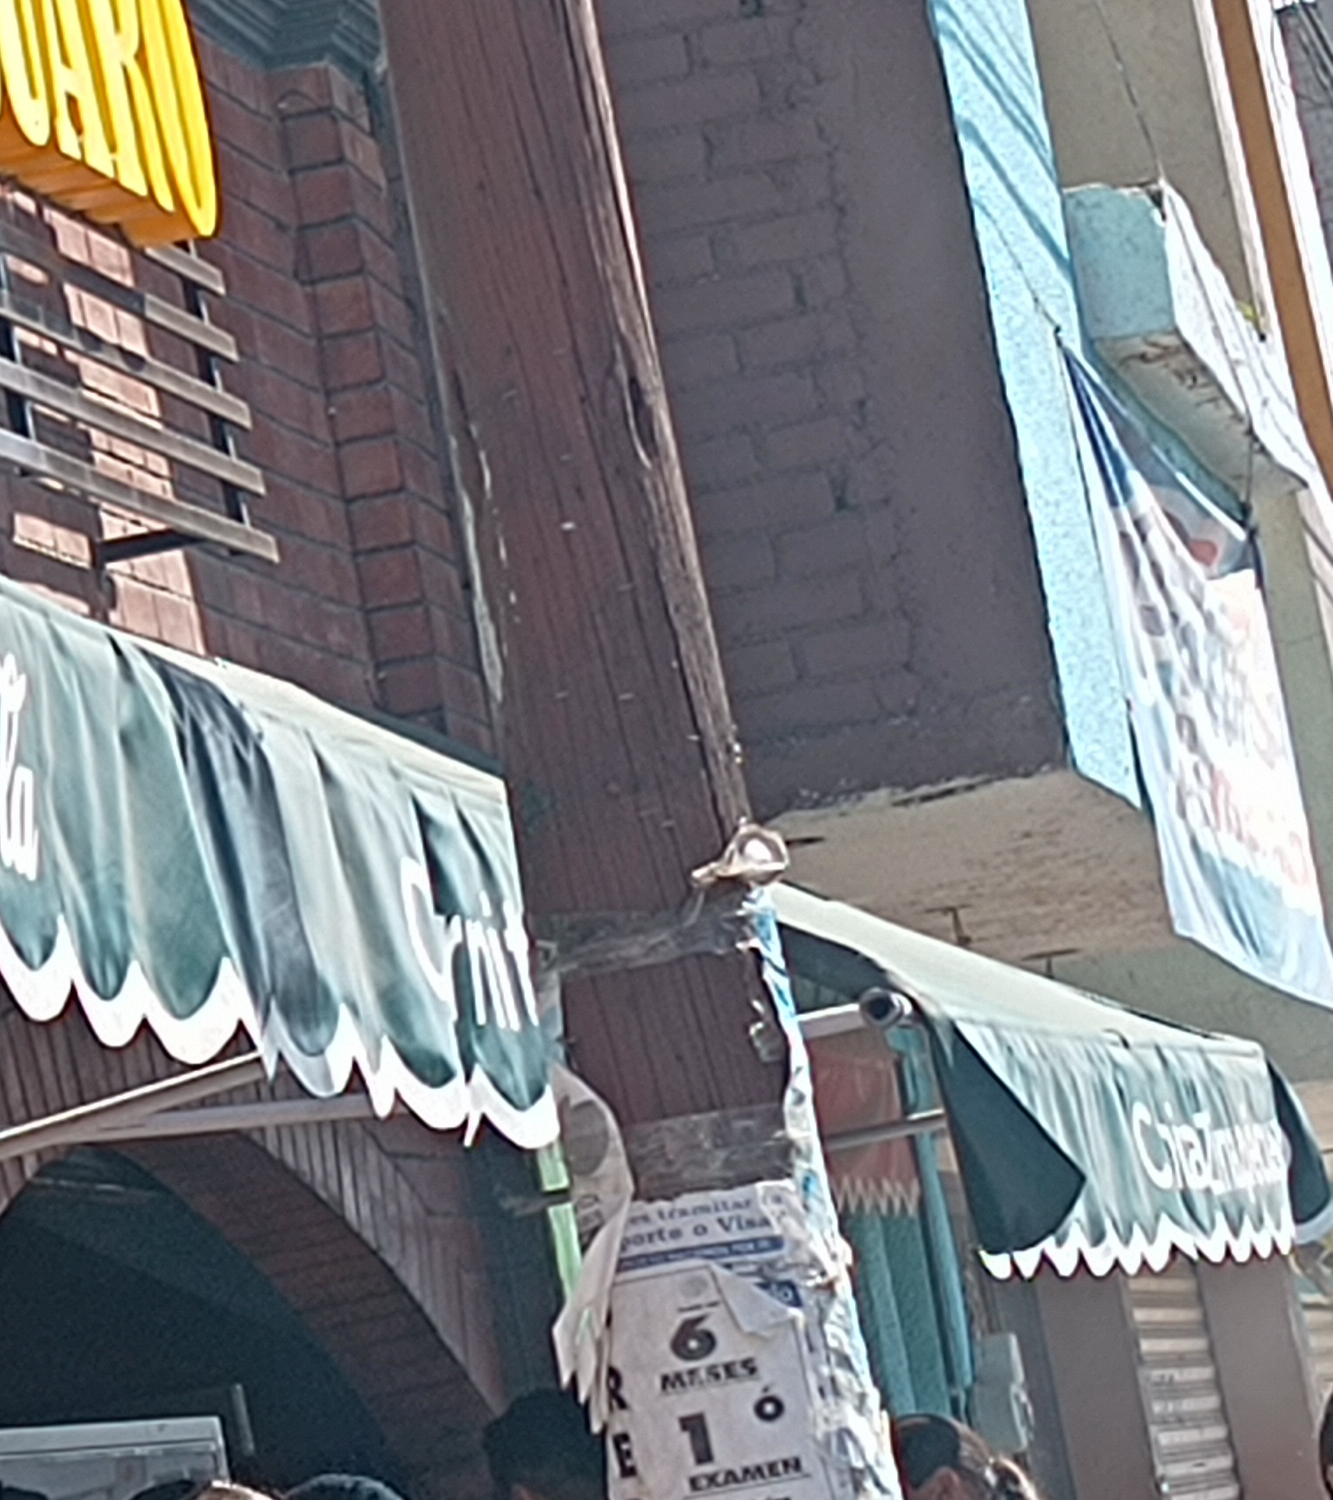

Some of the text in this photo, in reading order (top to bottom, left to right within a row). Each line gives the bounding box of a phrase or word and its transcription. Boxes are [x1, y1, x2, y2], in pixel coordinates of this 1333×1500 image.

[670, 1313, 717, 1361] 6
[660, 1357, 758, 1391] MESES
[678, 1411, 715, 1465] 1
[688, 1456, 803, 1492] EXAMEN
